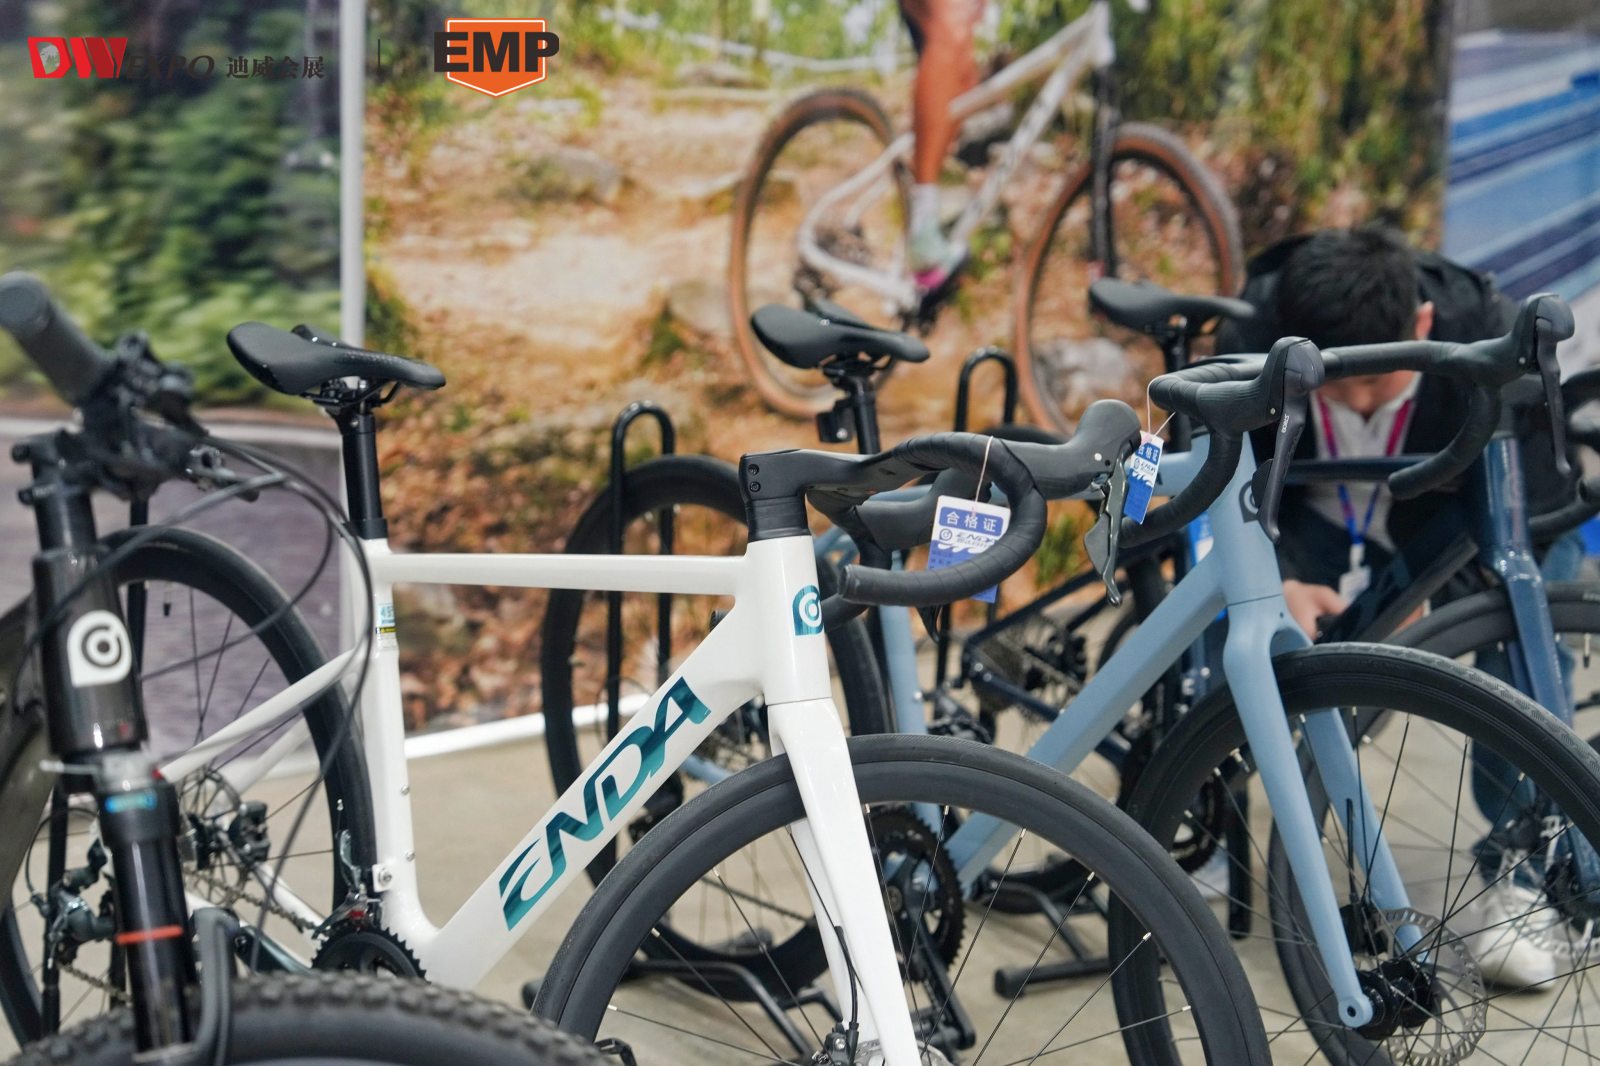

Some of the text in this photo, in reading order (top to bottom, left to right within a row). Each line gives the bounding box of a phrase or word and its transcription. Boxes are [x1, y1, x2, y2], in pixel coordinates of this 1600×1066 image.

[946, 511, 997, 532] 合格证
[498, 676, 712, 931] ENDA
